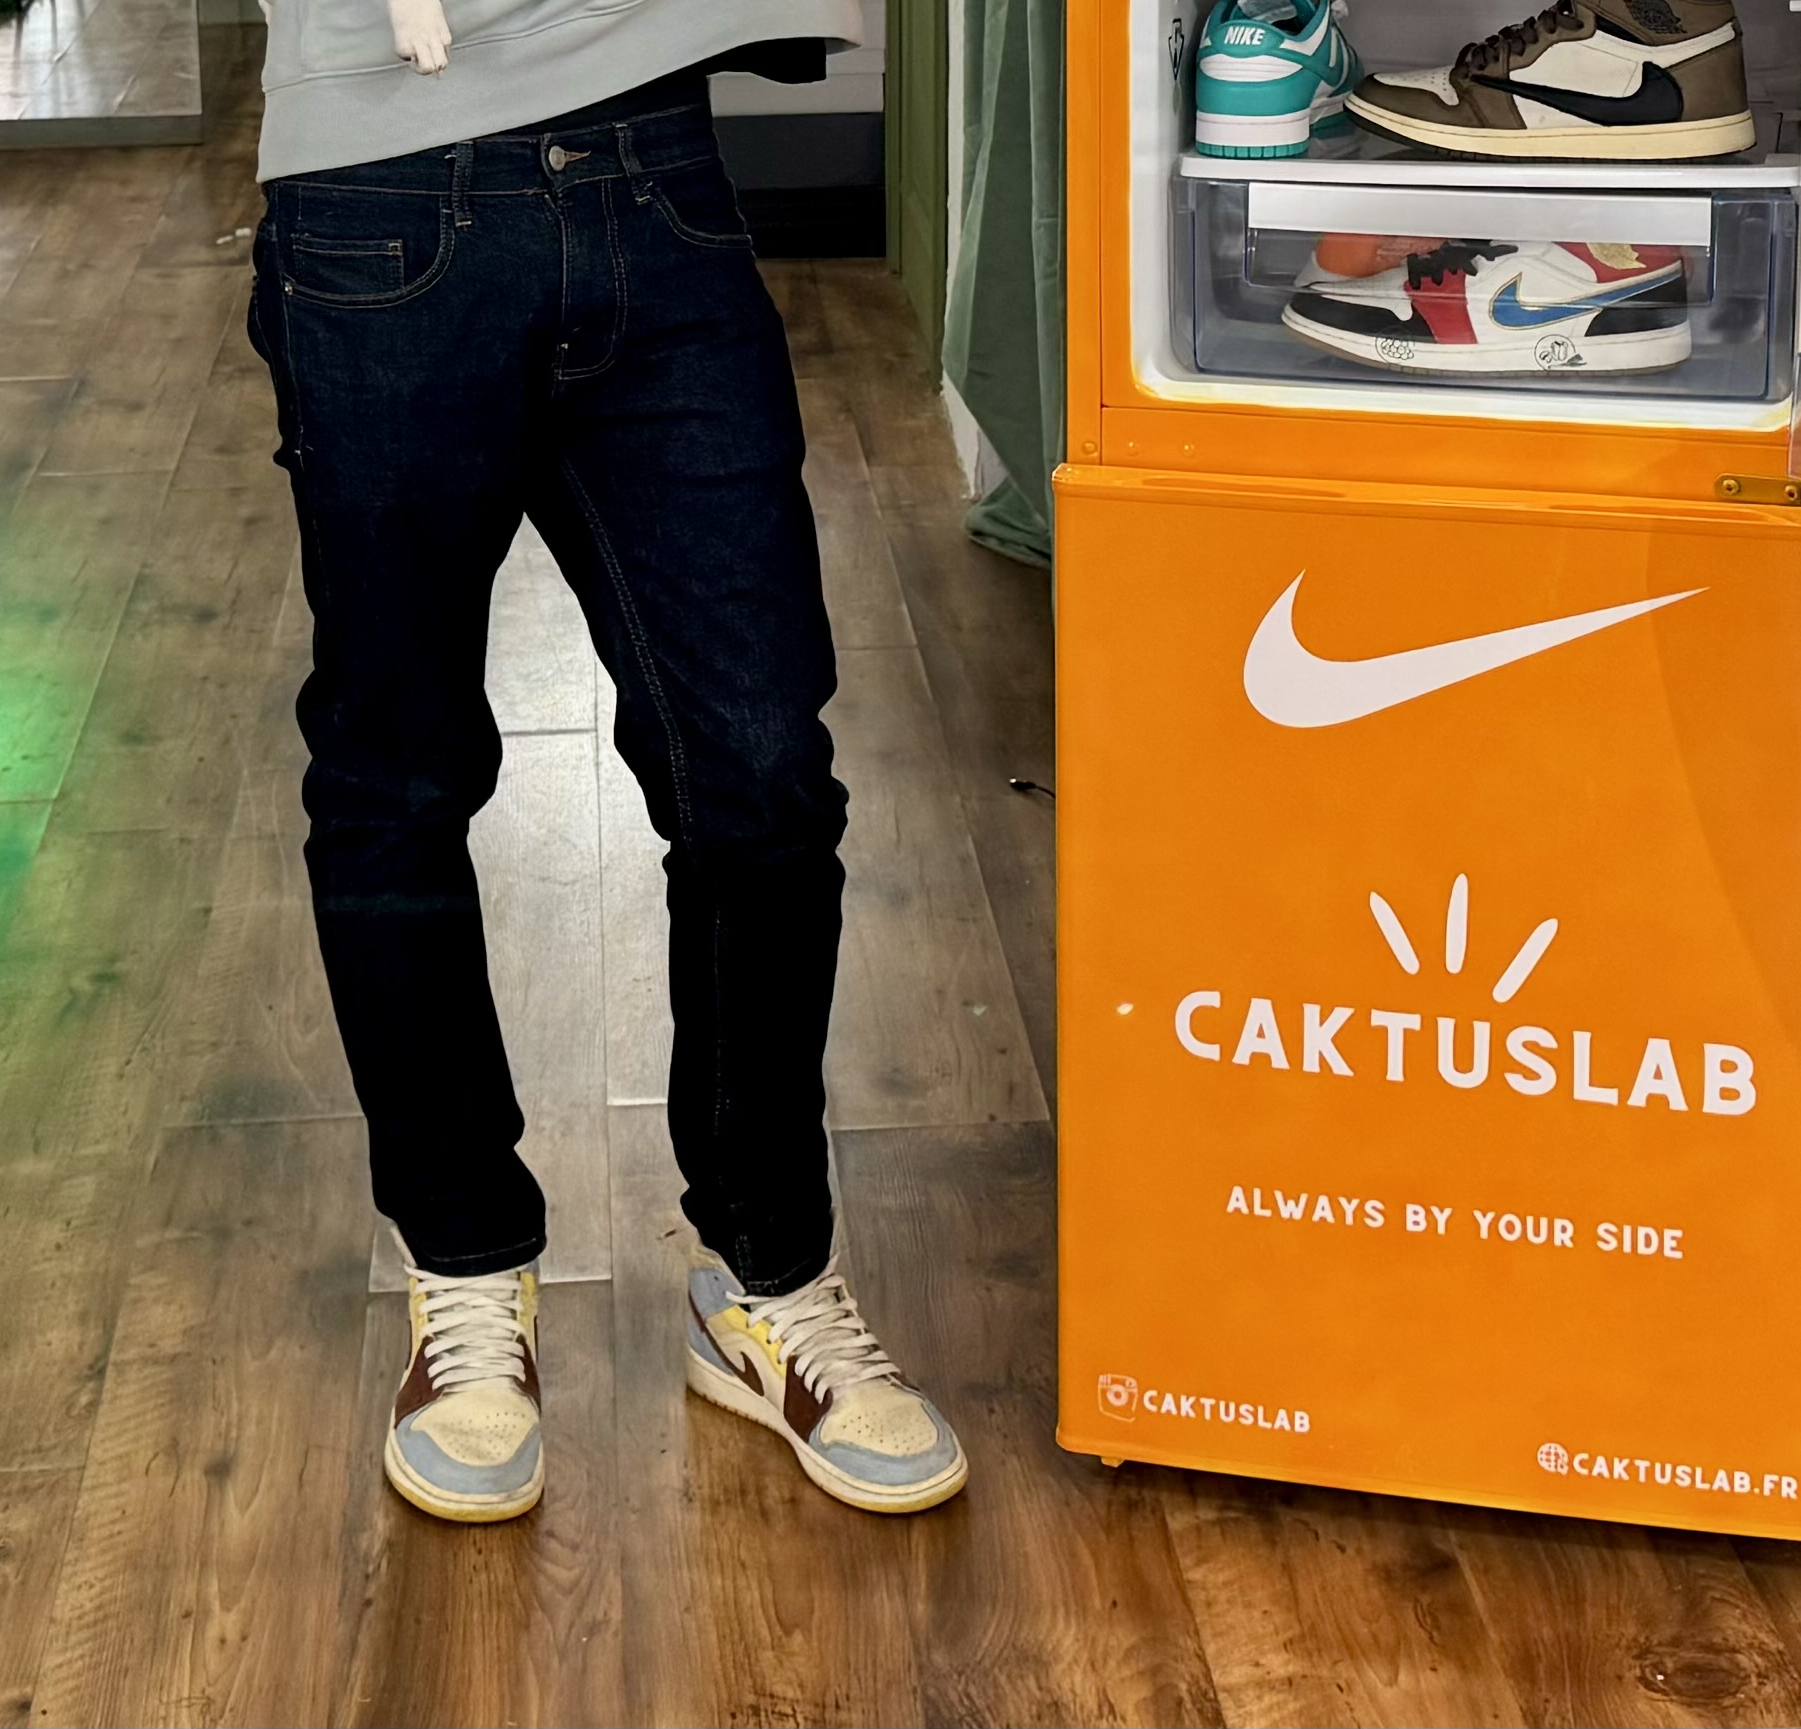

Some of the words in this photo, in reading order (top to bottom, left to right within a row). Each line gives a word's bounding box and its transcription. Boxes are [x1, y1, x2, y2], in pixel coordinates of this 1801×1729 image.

[1224, 26, 1265, 45] NIKE
[1175, 991, 1757, 1116] CAKTUSLAB
[1227, 1186, 1385, 1228] ALWAYS
[1406, 1204, 1451, 1234] BY
[1474, 1211, 1574, 1248] YOUR
[1597, 1223, 1683, 1259] SIDE
[1143, 1390, 1310, 1433] CAKTUSLAB
[1573, 1453, 1797, 1500] CAKTUSLAB.FR
